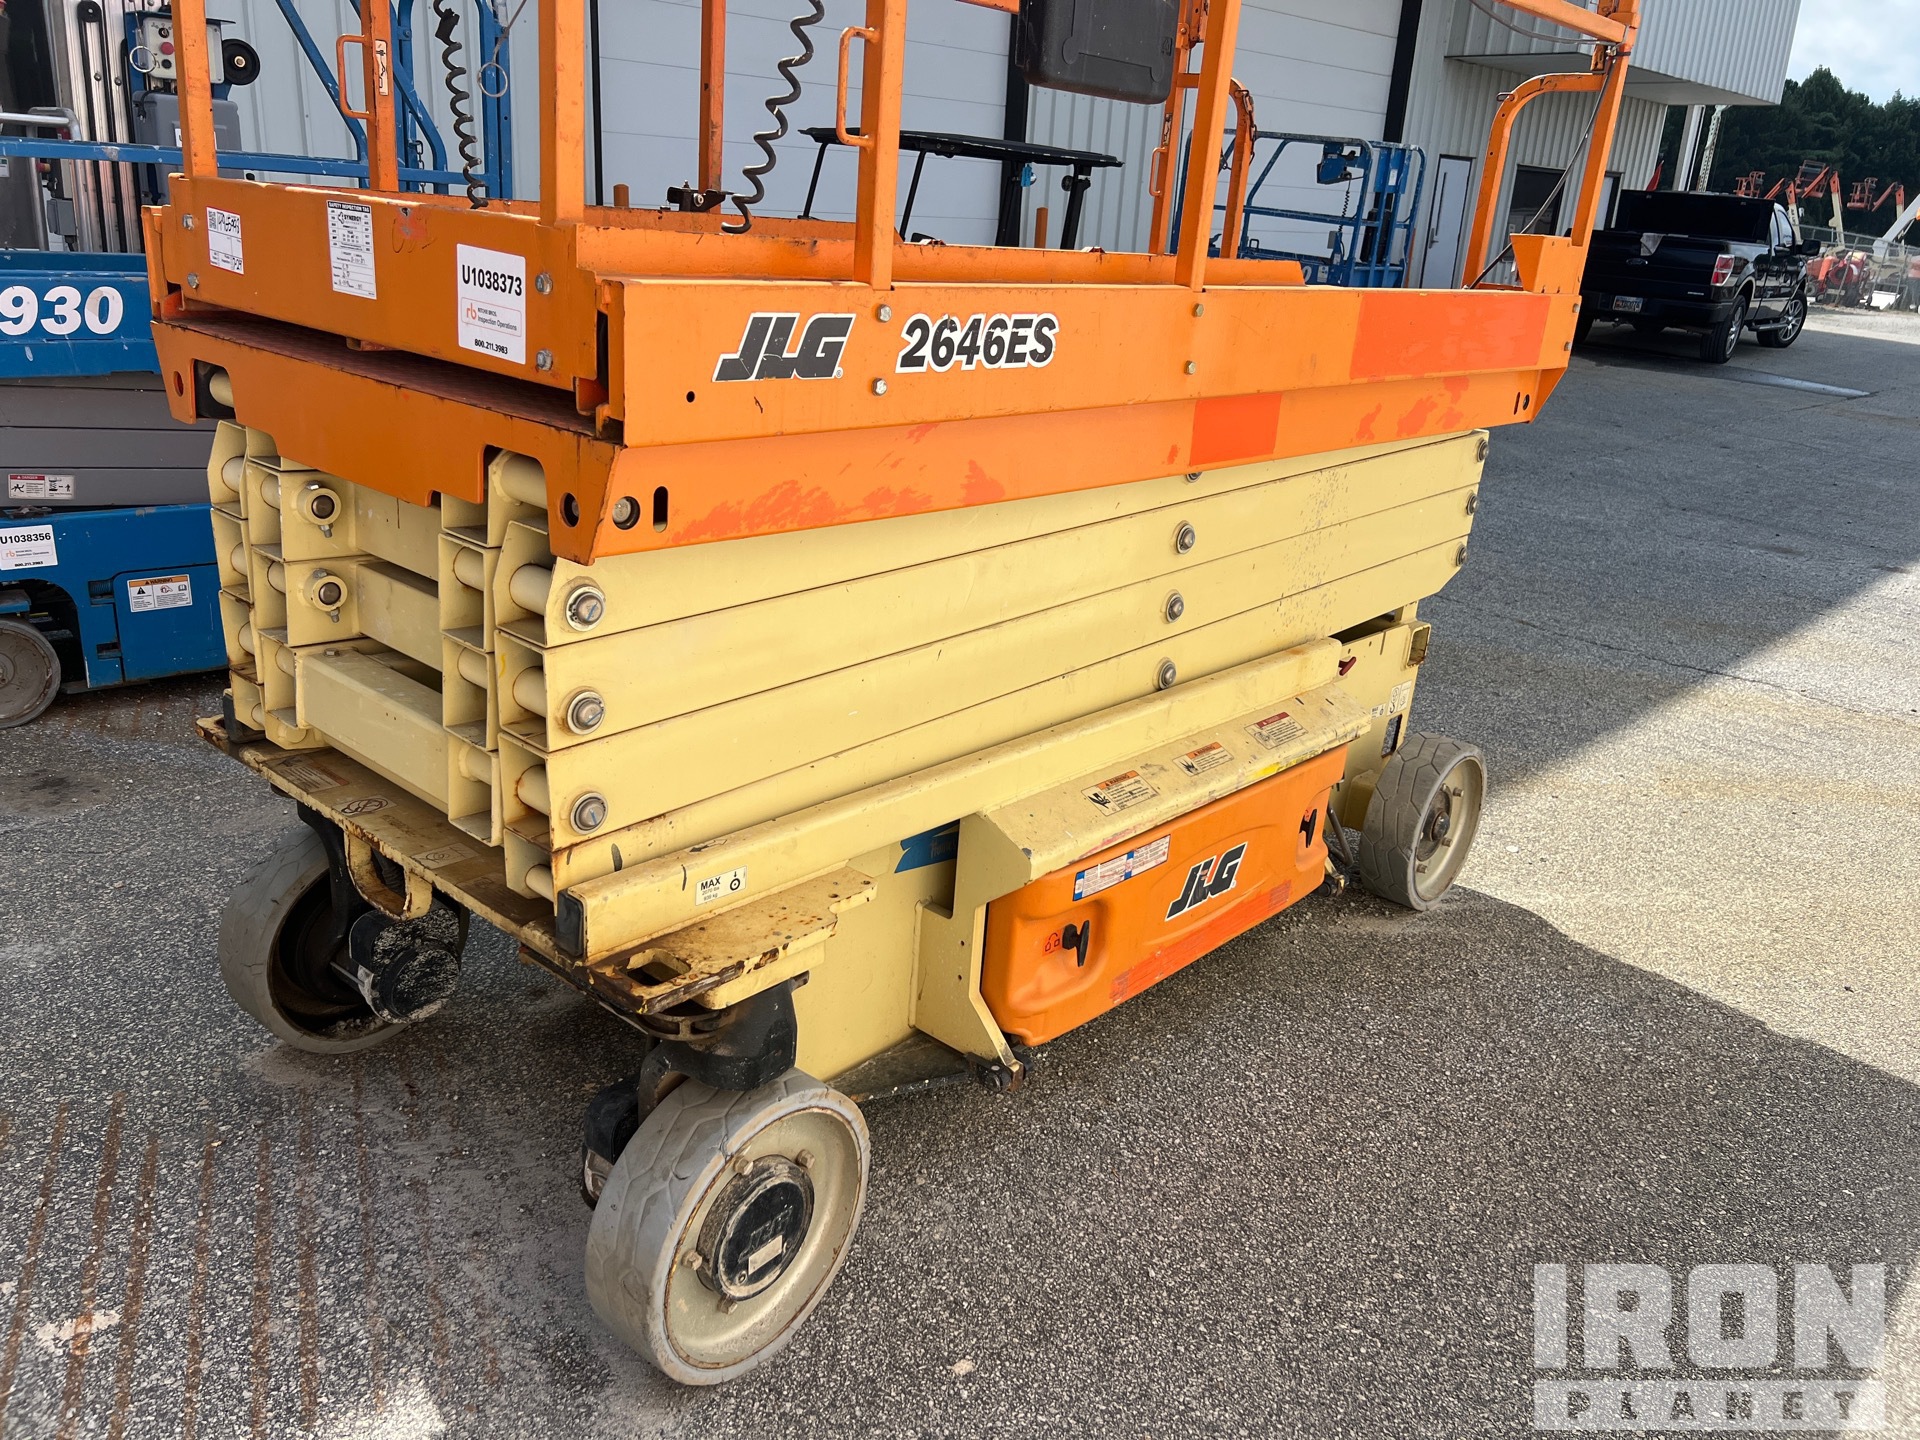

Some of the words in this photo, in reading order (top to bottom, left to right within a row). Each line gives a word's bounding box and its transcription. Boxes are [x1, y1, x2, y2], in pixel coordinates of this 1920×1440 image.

[462, 264, 522, 297] U1038373
[0, 285, 124, 335] 930
[466, 302, 477, 320] rb
[478, 315, 497, 326] Inspection
[497, 319, 518, 331] Operations
[474, 338, 508, 354] 800.211.3983
[713, 313, 855, 381] JLG
[899, 317, 1057, 368] 2646ES
[0, 532, 51, 545] U1038356
[700, 876, 721, 891] MAX
[1166, 842, 1248, 920] JLG
